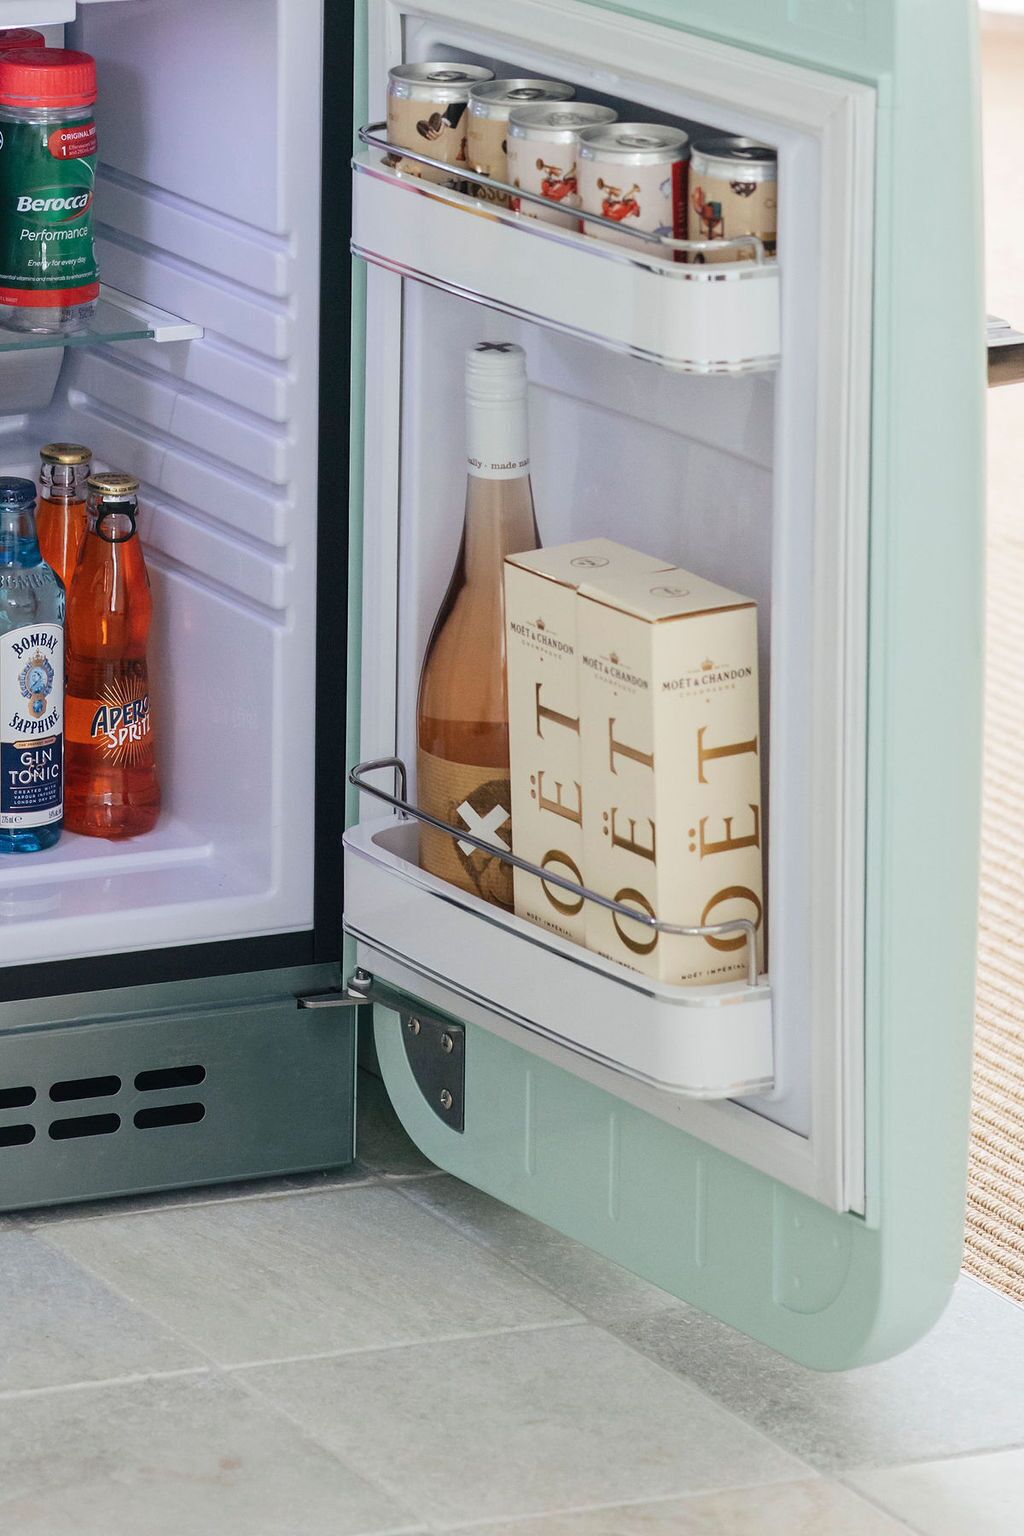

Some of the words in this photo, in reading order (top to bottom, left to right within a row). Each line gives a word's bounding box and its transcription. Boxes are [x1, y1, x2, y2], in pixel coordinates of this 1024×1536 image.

[61, 130, 89, 141] ORIGINAL
[61, 146, 67, 156] 1
[17, 193, 88, 212] Berocca
[20, 227, 88, 241] Performance
[491, 461, 517, 470] made
[11, 632, 58, 659] BOMBAY
[536, 633, 574, 655] CHANDON
[609, 666, 649, 689] CHANDON
[701, 666, 752, 685] CHANDON
[9, 706, 60, 734] SAPPHIRE
[20, 748, 52, 765] GIN
[8, 764, 59, 784] TONIC
